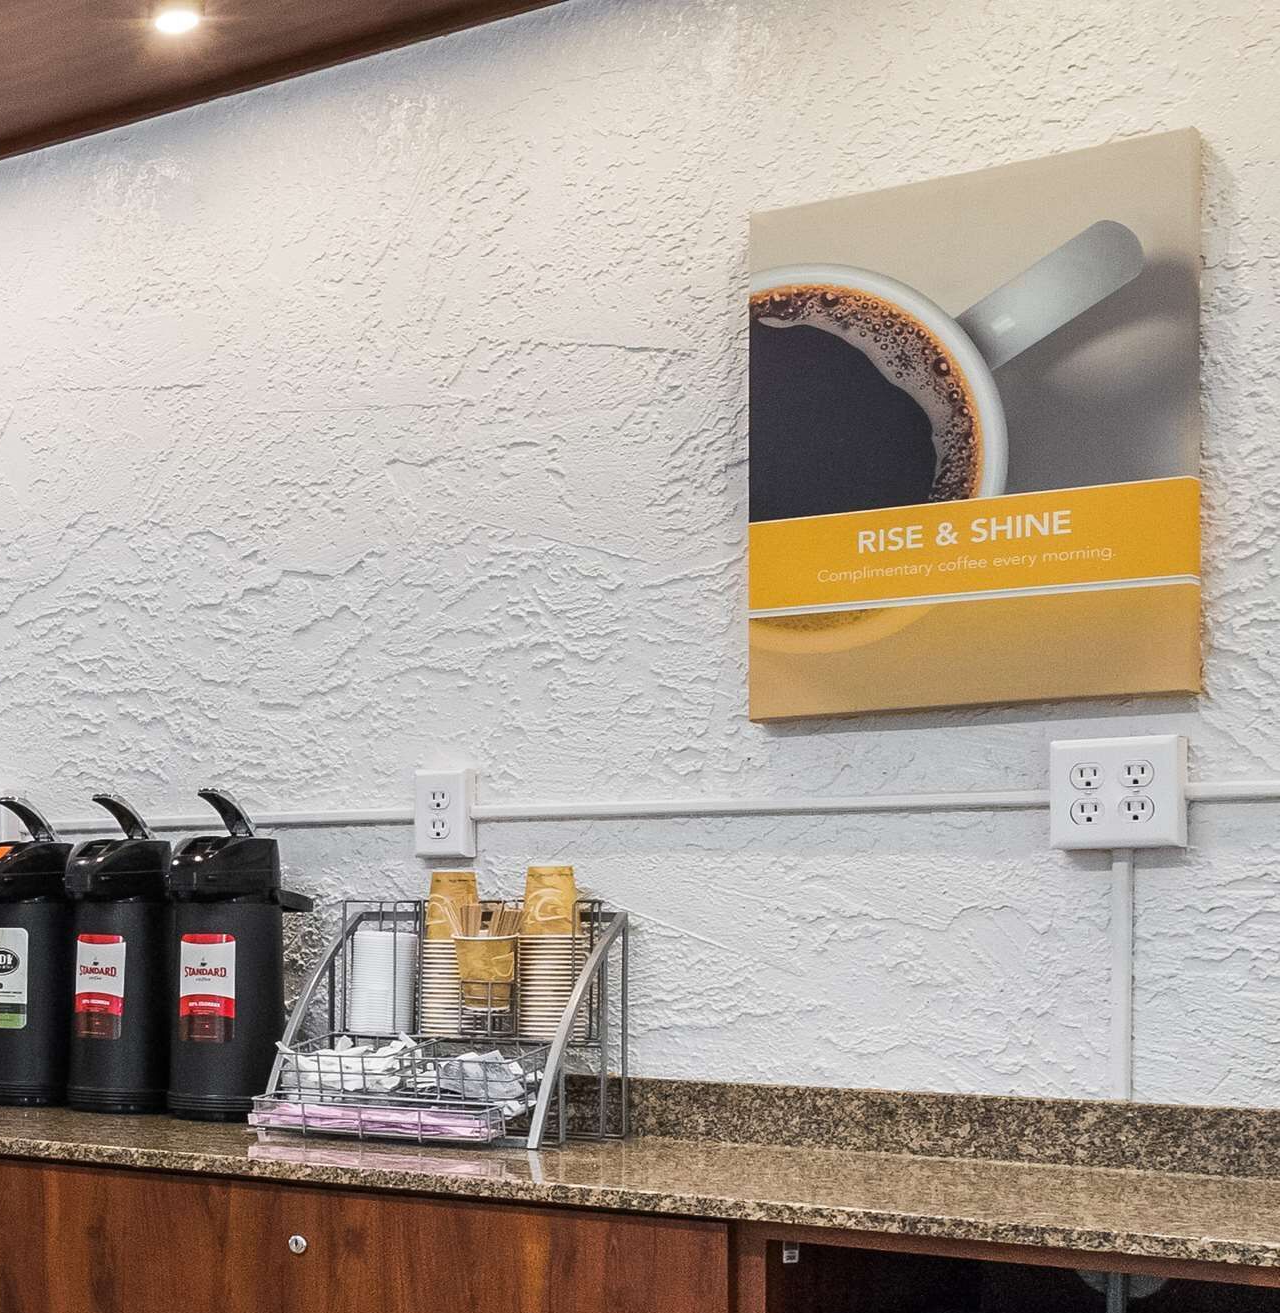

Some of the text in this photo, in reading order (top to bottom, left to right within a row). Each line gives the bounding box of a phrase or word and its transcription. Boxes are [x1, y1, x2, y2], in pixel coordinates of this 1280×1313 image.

[857, 510, 1072, 553] RISE & SHINE
[817, 545, 1116, 584] Complimentary coffee every morning.
[80, 965, 117, 977] STANDARD
[184, 966, 227, 978] STANDARD
